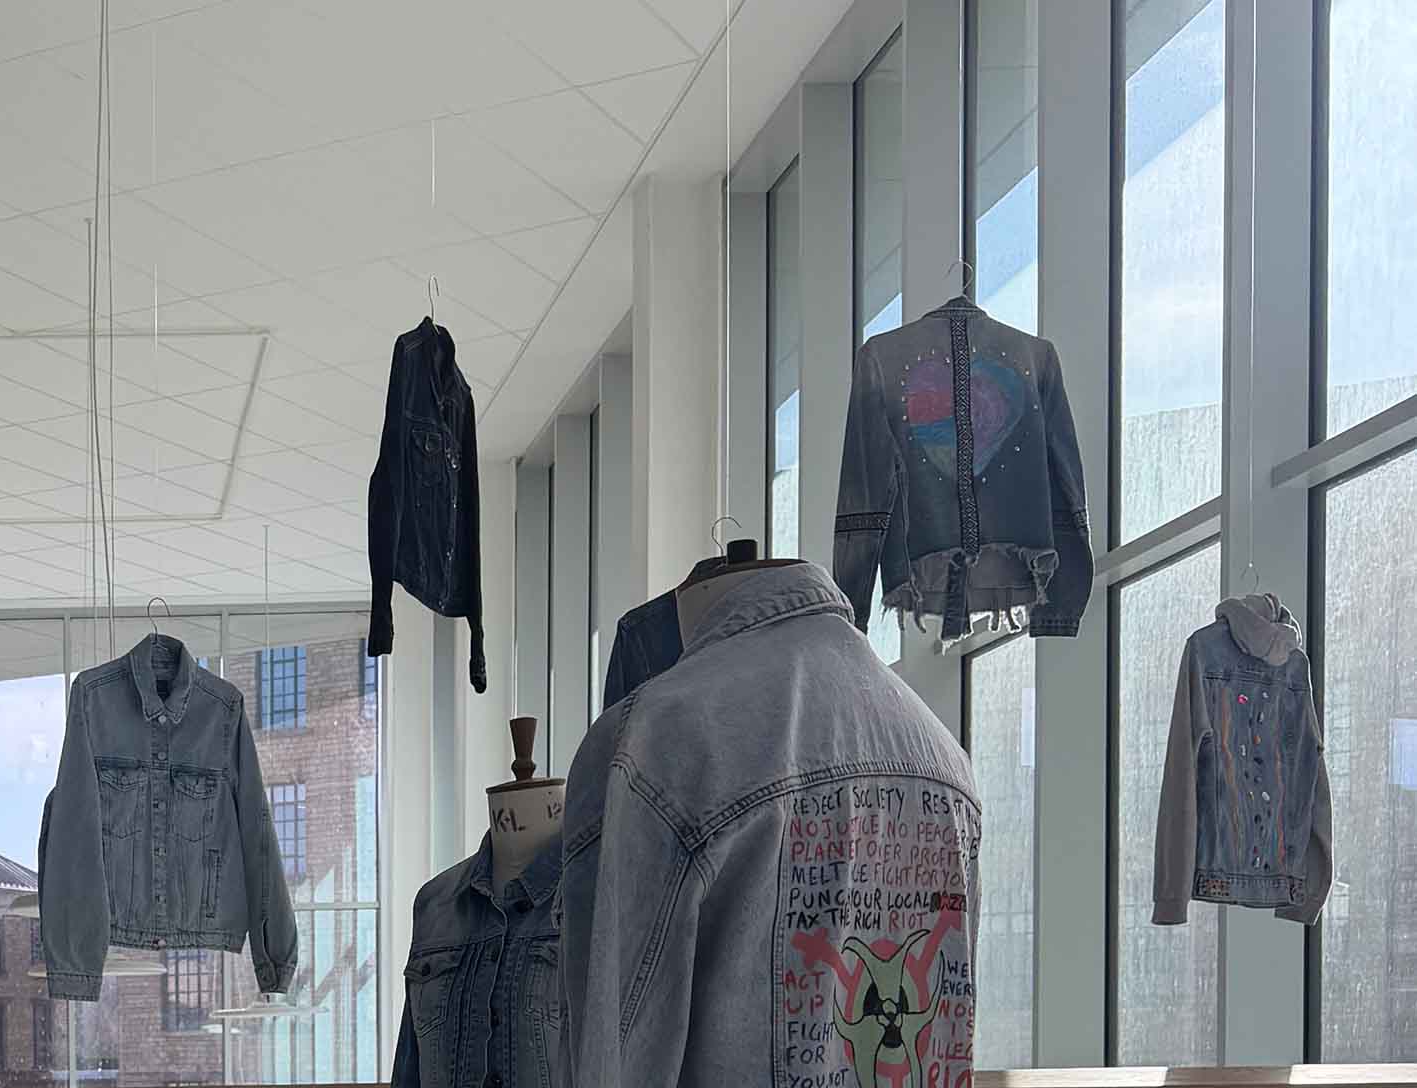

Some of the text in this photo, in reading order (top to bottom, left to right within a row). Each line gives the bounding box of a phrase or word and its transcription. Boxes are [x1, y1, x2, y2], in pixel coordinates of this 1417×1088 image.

[789, 817, 819, 839] NO
[886, 819, 908, 840] NO
[791, 839, 862, 863] PLANET
[791, 860, 847, 887] MELT
[887, 889, 929, 912] LOCAL
[785, 902, 929, 932] TAX THE RICH RIOT
[785, 969, 827, 992] ACT
[947, 959, 969, 979] WE
[786, 993, 825, 1017] UP
[786, 1044, 826, 1067] FOR
